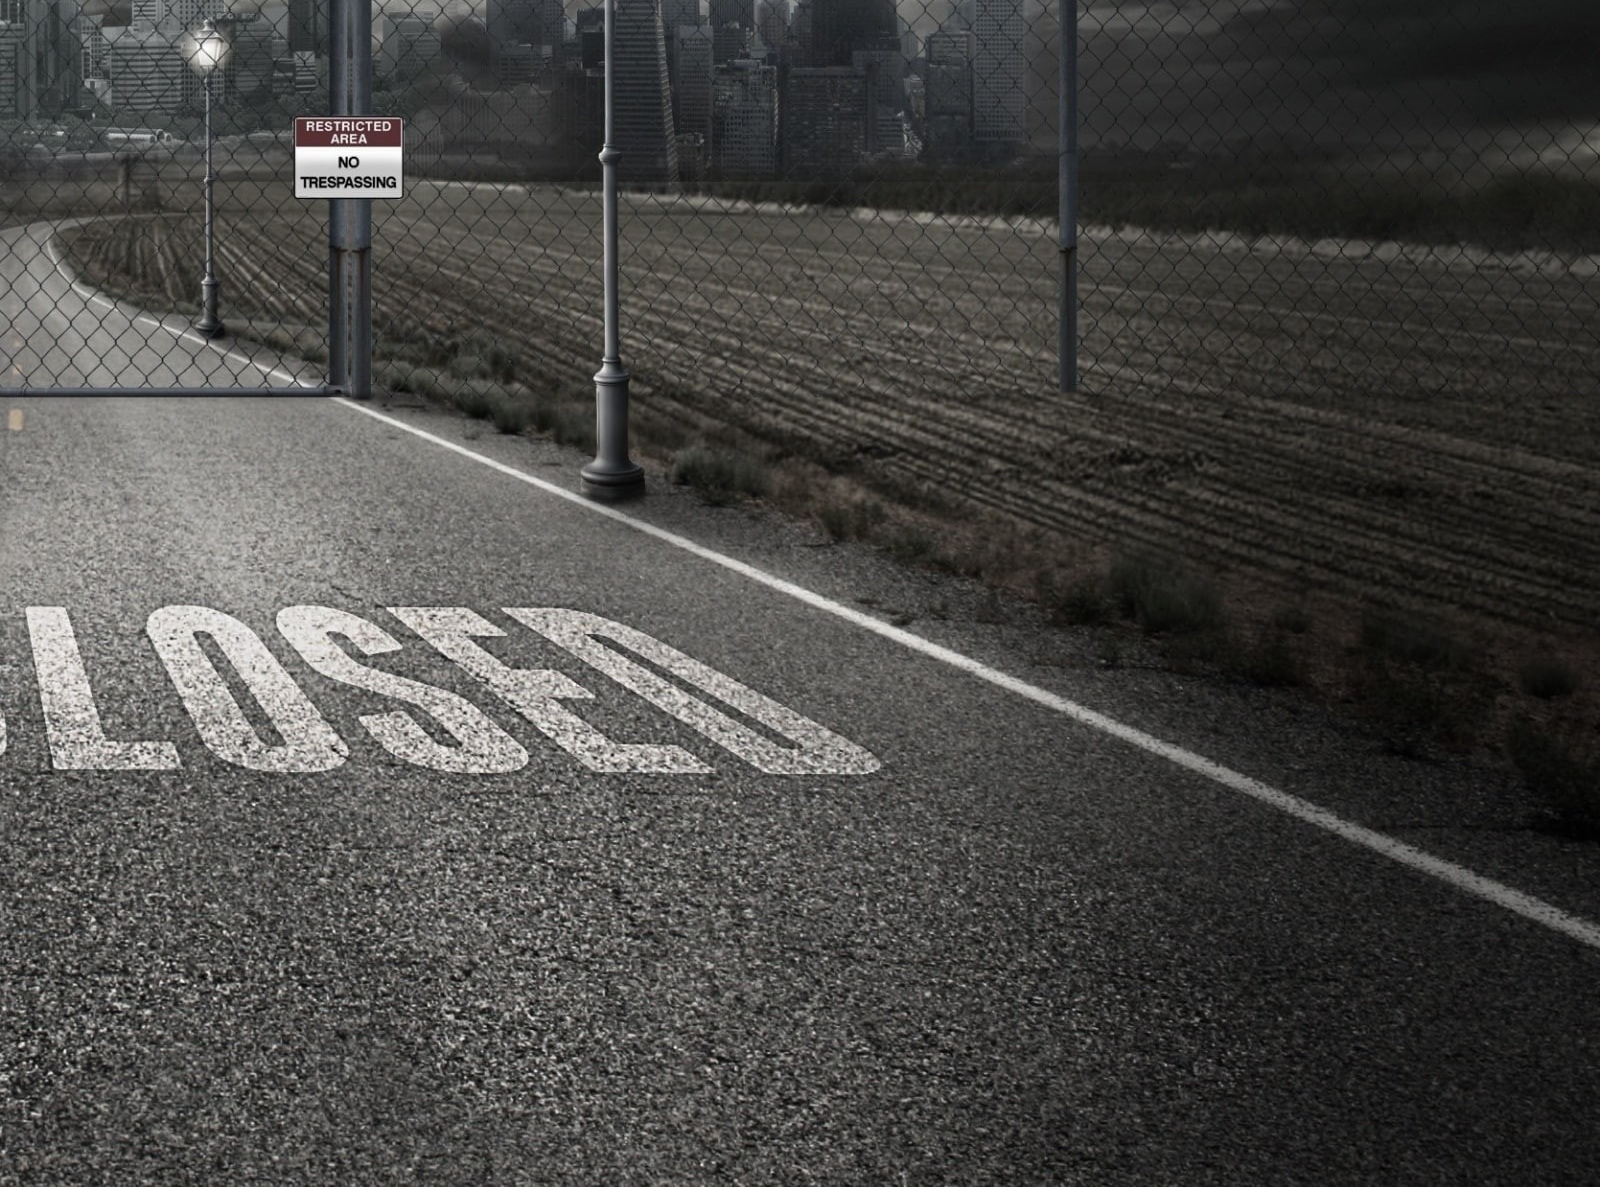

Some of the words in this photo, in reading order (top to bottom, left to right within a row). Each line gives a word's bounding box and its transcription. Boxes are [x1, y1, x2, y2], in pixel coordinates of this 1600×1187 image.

[306, 121, 392, 132] RESTRICTED
[330, 133, 368, 144] AREA
[338, 156, 360, 169] NO
[300, 176, 397, 189] TRESPASSING
